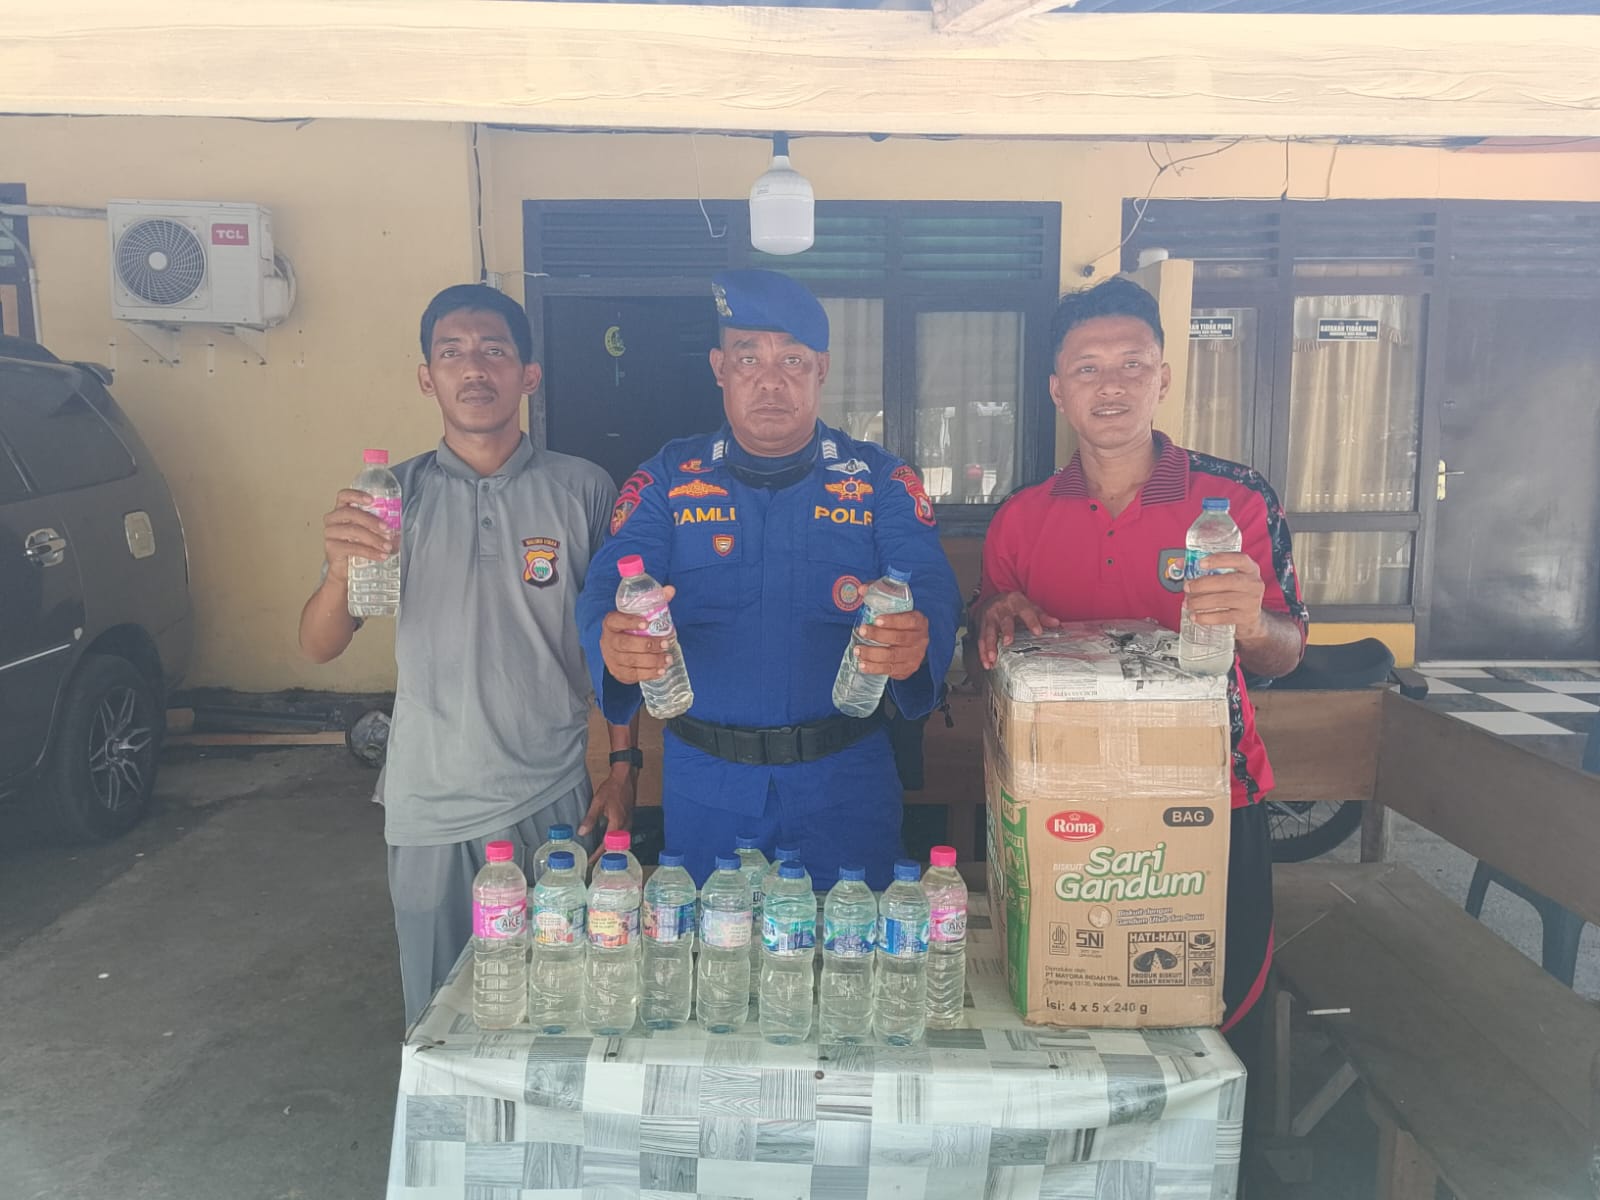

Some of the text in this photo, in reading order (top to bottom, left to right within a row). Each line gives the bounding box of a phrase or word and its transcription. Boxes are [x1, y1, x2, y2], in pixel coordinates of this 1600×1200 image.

[215, 229, 245, 240] TCL
[1172, 811, 1205, 823] BAG
[1054, 818, 1097, 834] Roma
[1085, 842, 1165, 876] Sari
[1055, 864, 1203, 901] Gandum
[1076, 930, 1104, 948] SNI
[1129, 932, 1185, 943] HATI-HATI
[1046, 997, 1148, 1014] Isi: 4 x 5 x 240 g
